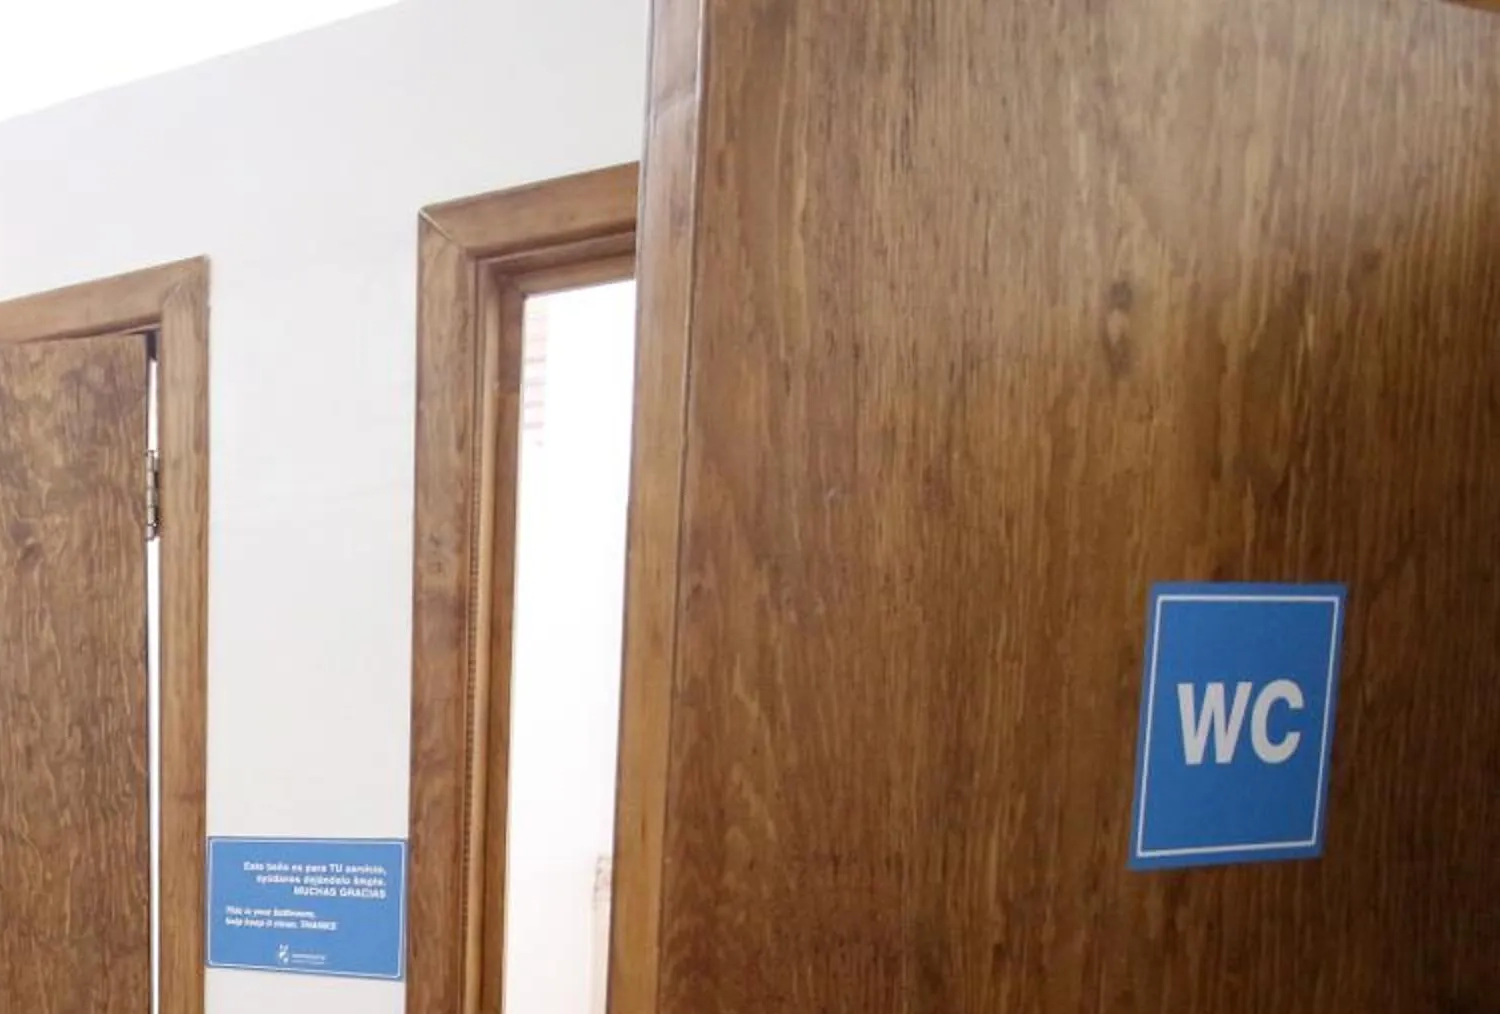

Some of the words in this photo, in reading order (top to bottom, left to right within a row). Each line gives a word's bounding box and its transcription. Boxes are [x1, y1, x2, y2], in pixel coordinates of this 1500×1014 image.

[1176, 678, 1304, 767] WC
[292, 864, 303, 872] es
[306, 864, 327, 873] para
[329, 864, 343, 873] TU
[293, 886, 336, 897] MUCHAS
[340, 887, 386, 899] GRACIAS
